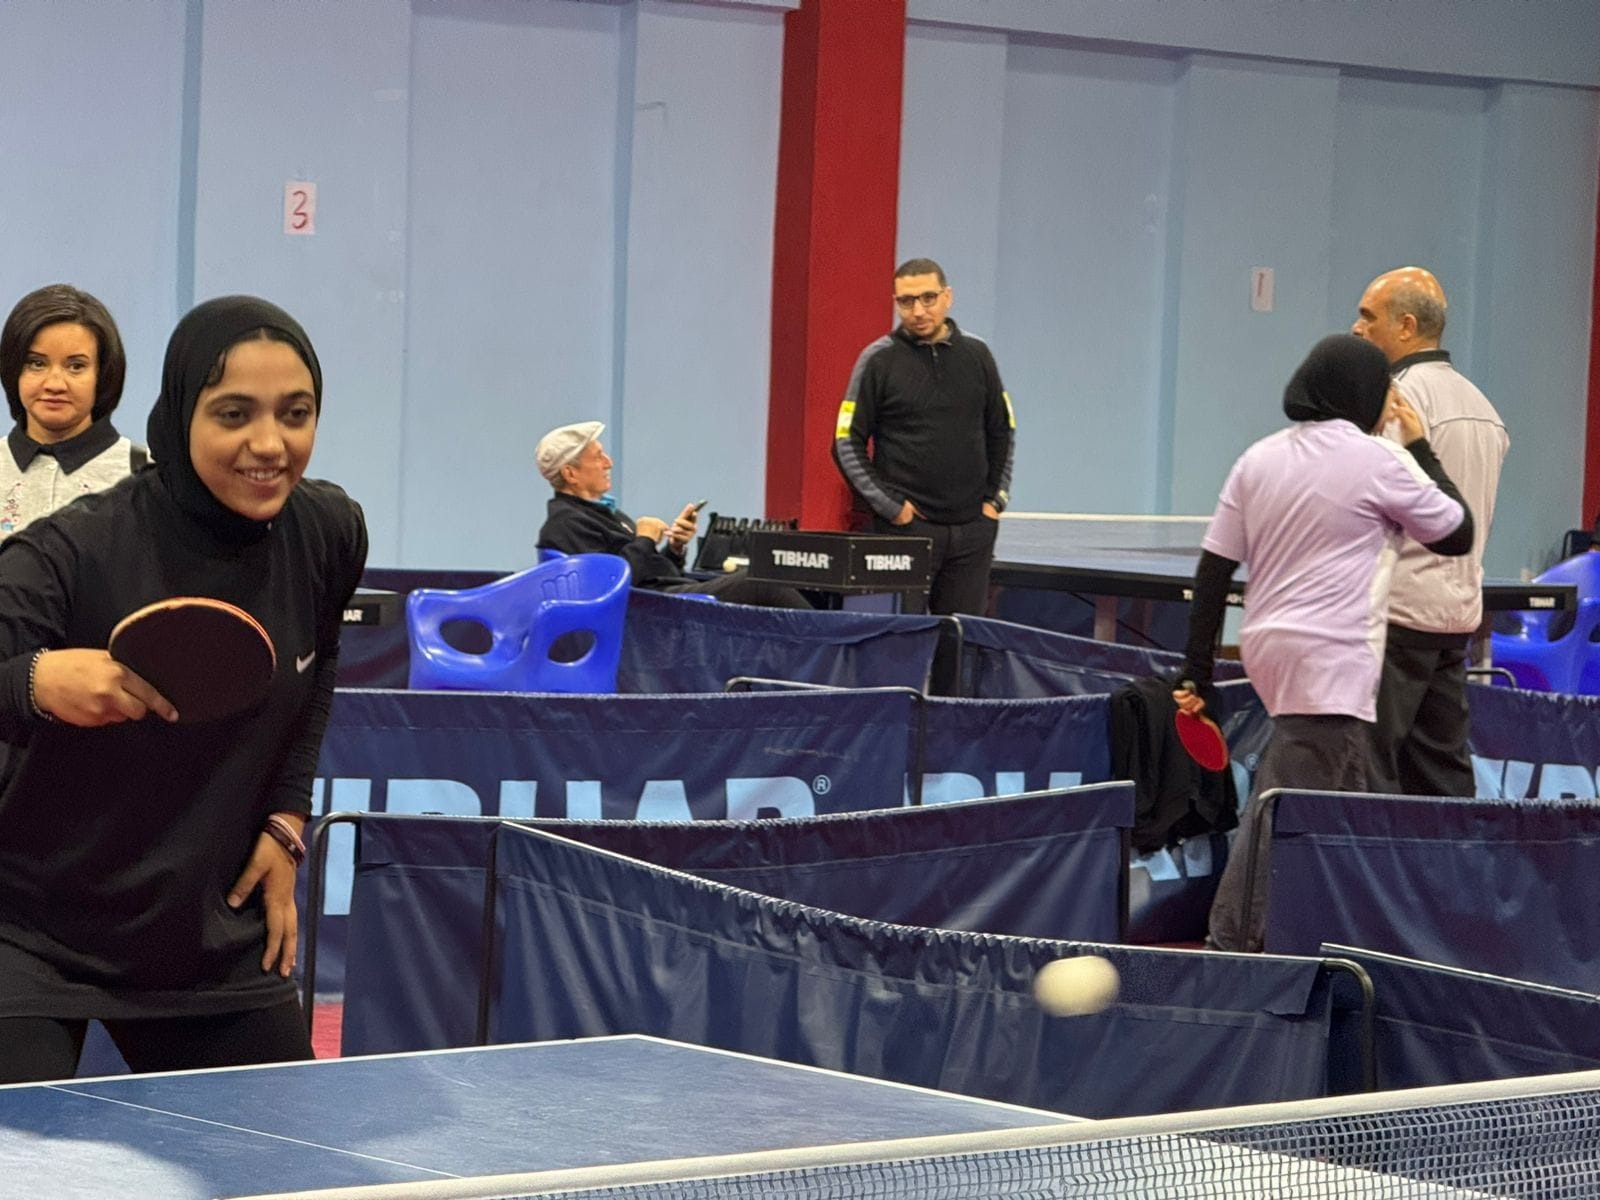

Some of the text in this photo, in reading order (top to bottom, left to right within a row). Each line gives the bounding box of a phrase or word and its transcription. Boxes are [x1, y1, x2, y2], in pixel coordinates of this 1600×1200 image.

[293, 190, 308, 229] 3
[772, 550, 831, 569] TIBHAR
[865, 555, 912, 571] TIBHAR
